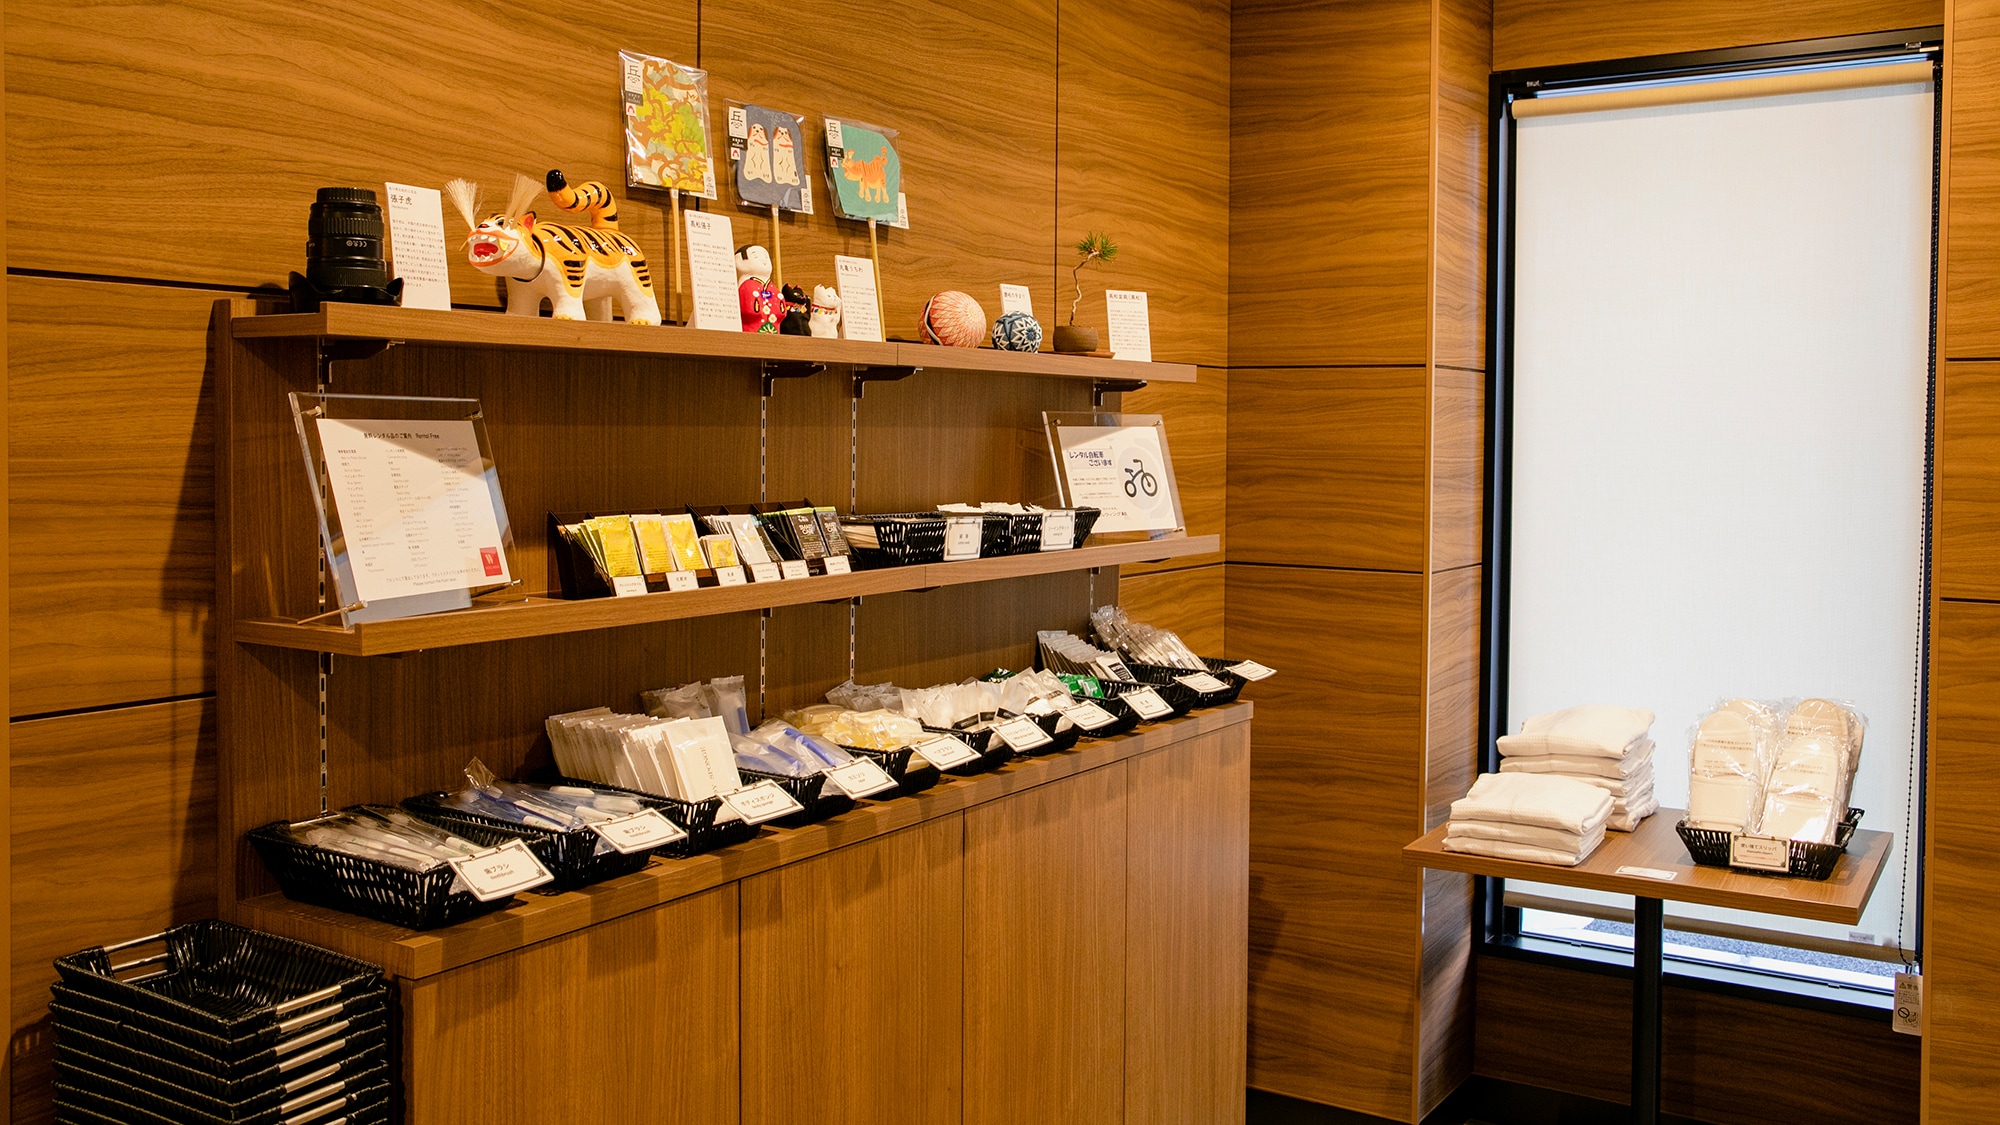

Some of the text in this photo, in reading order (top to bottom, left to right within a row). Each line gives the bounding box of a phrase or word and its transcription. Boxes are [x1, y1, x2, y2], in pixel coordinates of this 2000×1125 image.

[390, 194, 412, 206] 張子虎
[1069, 451, 1104, 459] レンタル自転車
[485, 554, 494, 564] W
[484, 863, 510, 875] 歯ブラシ
